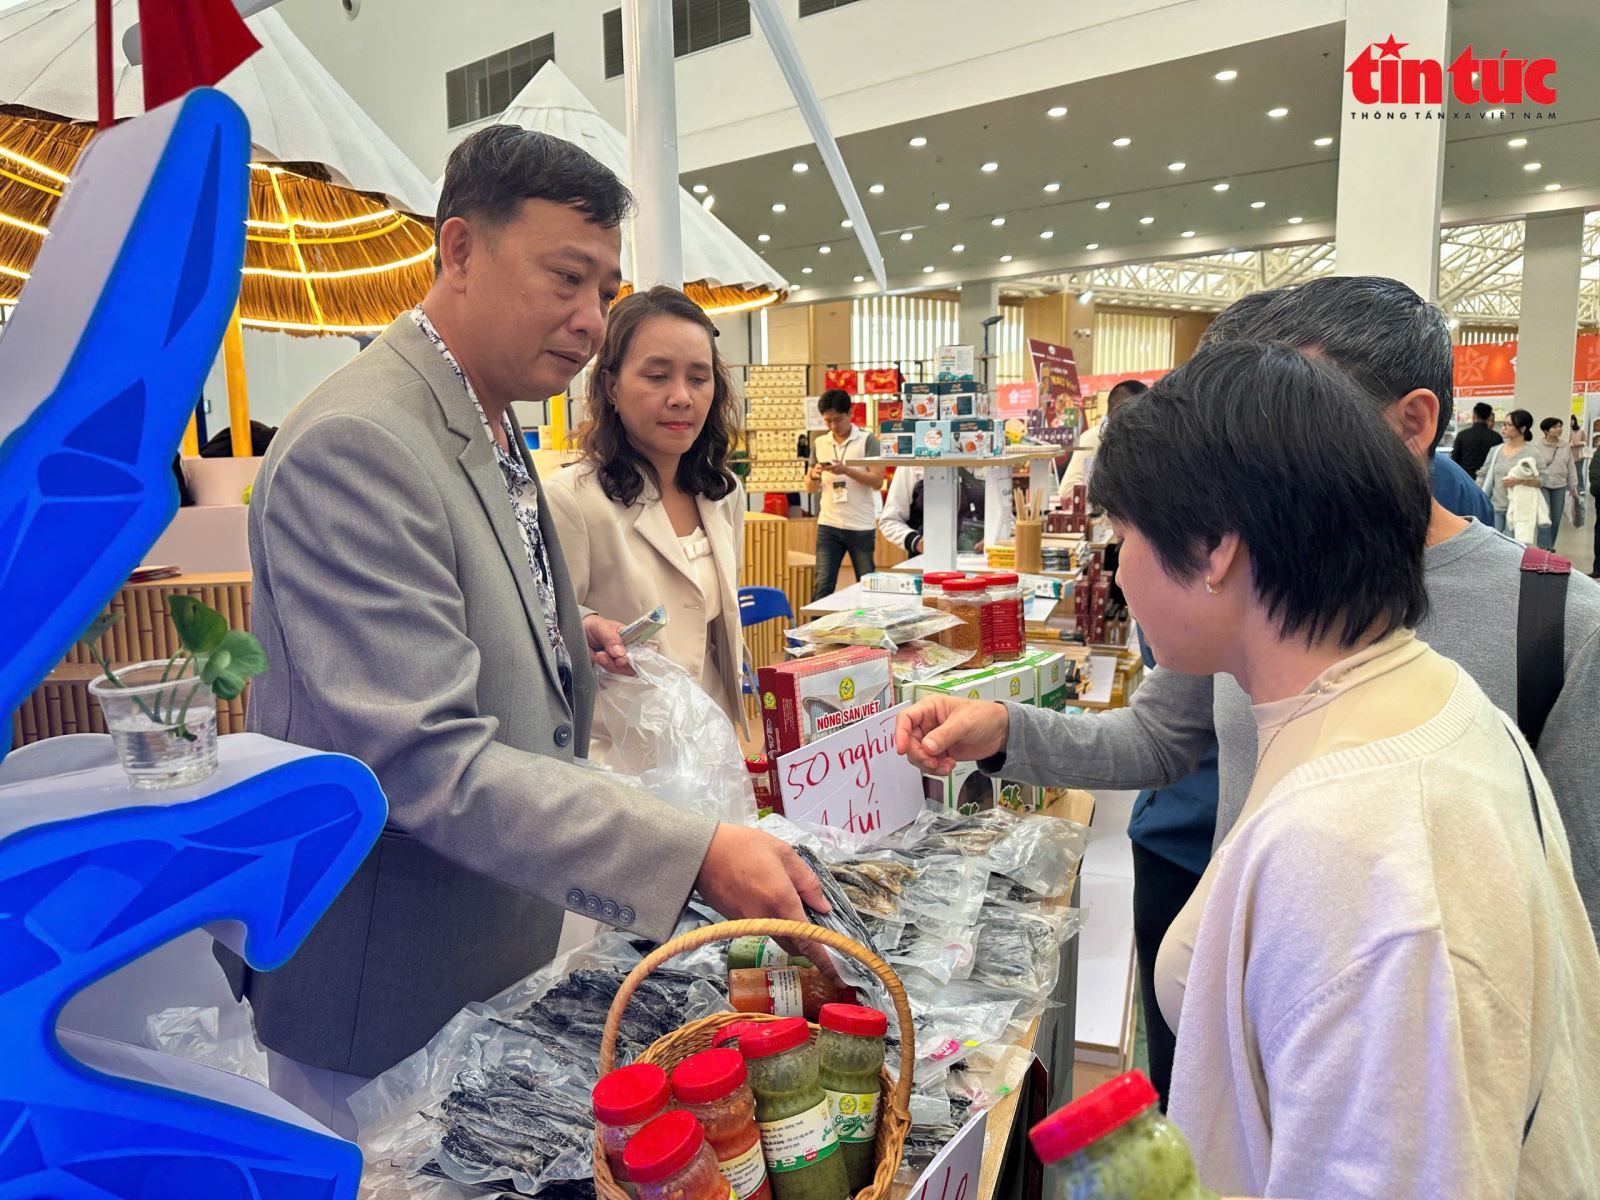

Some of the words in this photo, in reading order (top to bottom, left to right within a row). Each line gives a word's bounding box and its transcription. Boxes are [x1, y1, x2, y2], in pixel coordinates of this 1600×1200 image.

[816, 711, 841, 731] NÔNG
[843, 705, 861, 723] SẢN
[862, 700, 880, 717] VIỆT
[787, 751, 830, 800] 50
[841, 782, 882, 834] túi
